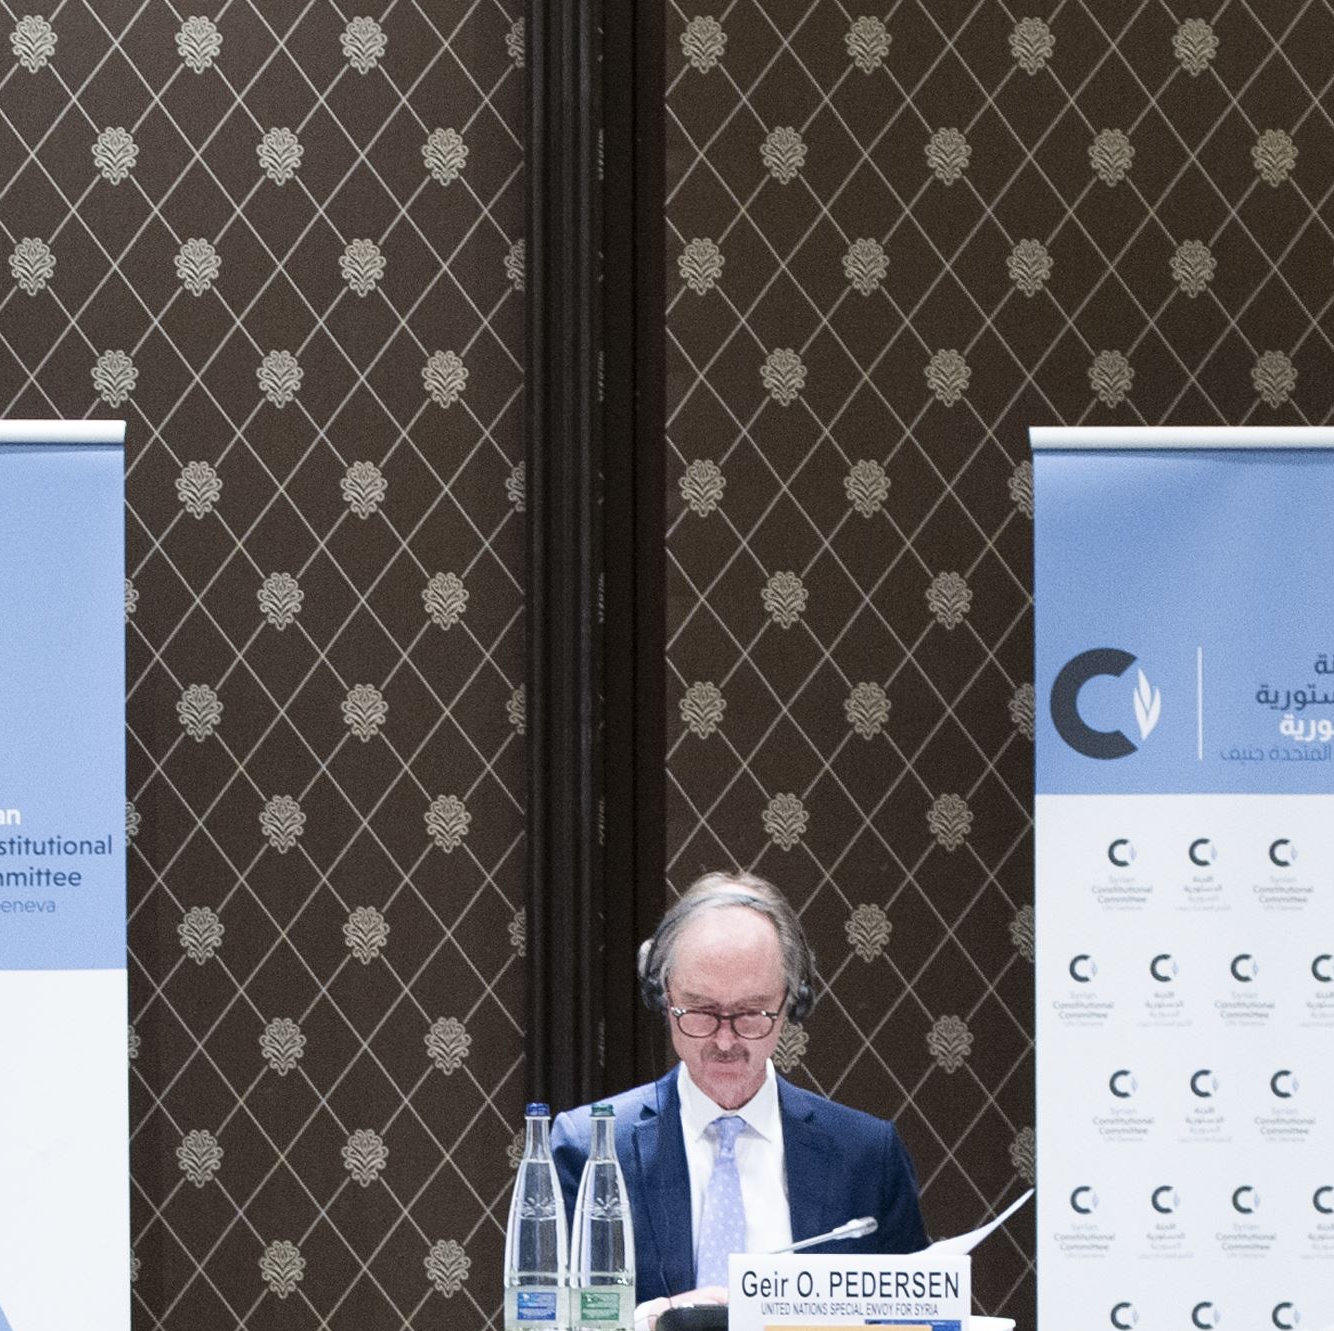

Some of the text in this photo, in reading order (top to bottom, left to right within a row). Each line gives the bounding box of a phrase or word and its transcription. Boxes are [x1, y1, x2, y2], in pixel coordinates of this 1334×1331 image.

[742, 1271, 958, 1298] Geir O. PEDERSEN
[762, 1303, 938, 1316] UNITED NATIONS SPECIAL ENVOY FOR SYRIA
